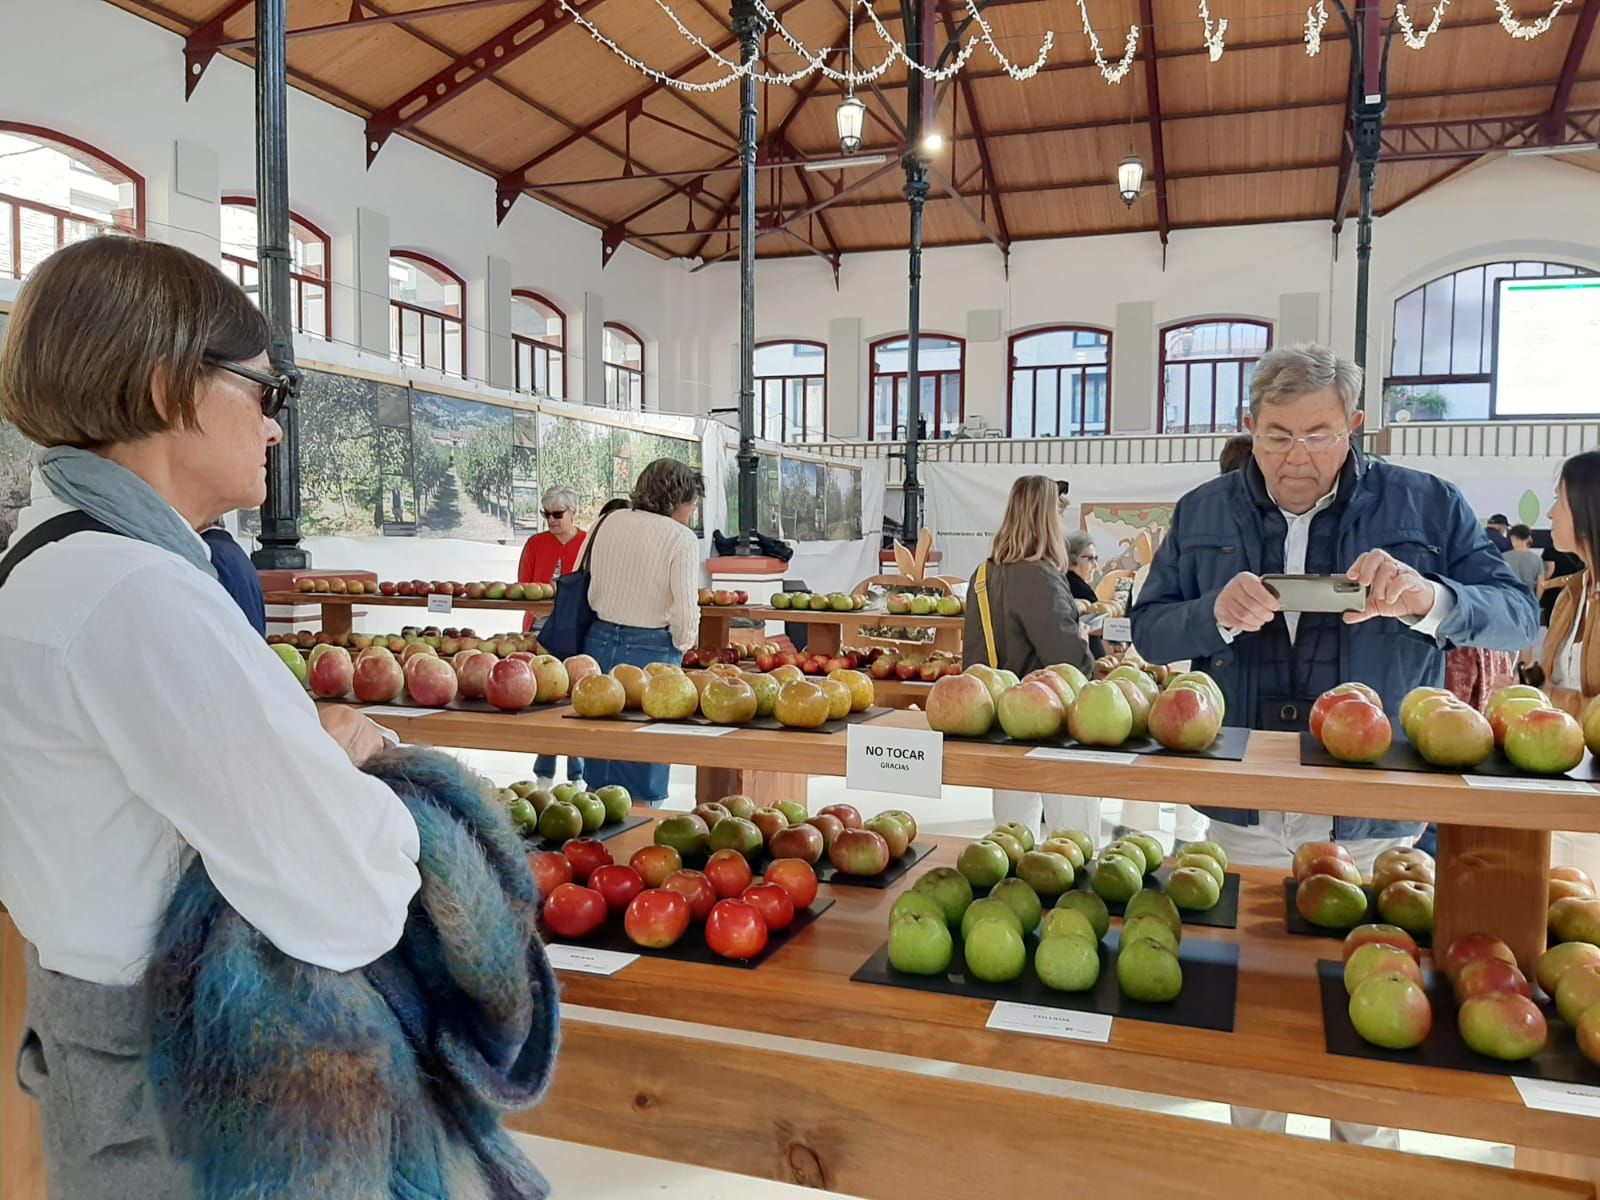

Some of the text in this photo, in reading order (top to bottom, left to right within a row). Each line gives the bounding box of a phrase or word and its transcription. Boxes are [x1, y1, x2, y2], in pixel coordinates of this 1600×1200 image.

[865, 745, 925, 761] NO TOCAR
[880, 761, 910, 771] GRACIAS
